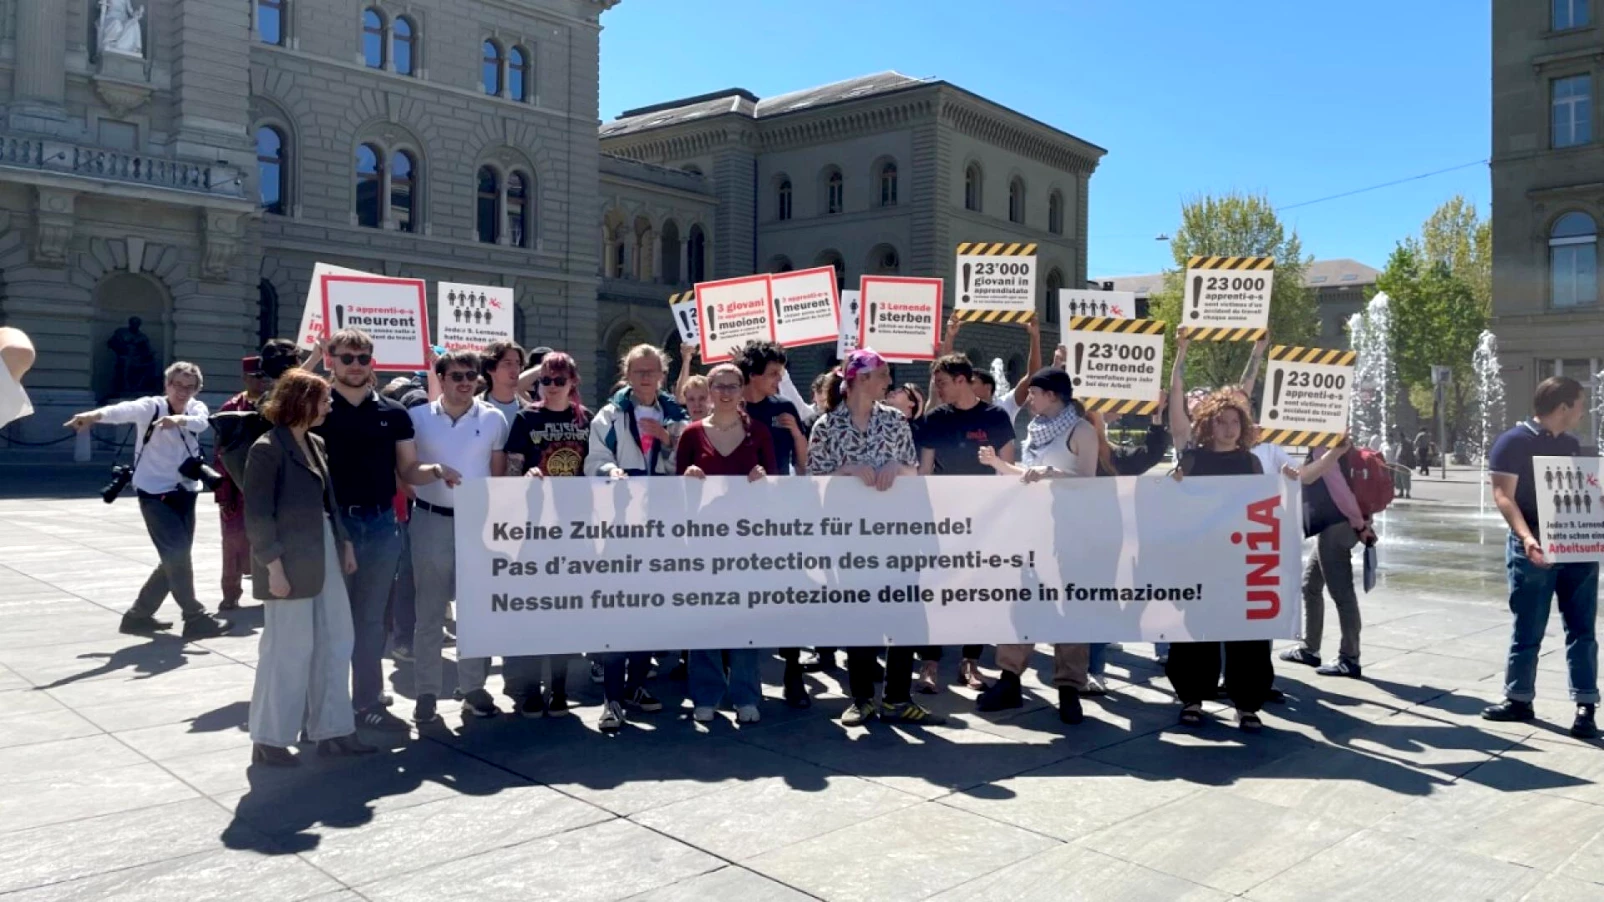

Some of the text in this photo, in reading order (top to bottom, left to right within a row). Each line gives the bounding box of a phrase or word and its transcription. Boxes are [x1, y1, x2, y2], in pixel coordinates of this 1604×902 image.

[974, 277, 1028, 287] giovani in
[1205, 293, 1263, 301] apprenti-e-s
[717, 299, 764, 313] 3 giovani
[783, 298, 830, 312] meurent
[879, 302, 931, 312] 3 Lernende
[356, 307, 414, 315] apprenti-e-s
[348, 316, 415, 327] meurent
[719, 317, 766, 329] muoiono
[879, 312, 931, 323] sterben
[1088, 343, 1155, 361] 23'000
[1087, 360, 1154, 374] Lernende
[1285, 390, 1344, 401] apprenti-e-s
[493, 518, 972, 541] Keine Zukunft ohne Schutz für Lernende!
[1547, 532, 1567, 540] hatte
[1569, 532, 1590, 540] schon
[492, 558, 538, 576] Pas
[650, 558, 704, 572] sans
[712, 552, 832, 575] protection
[838, 552, 879, 570] des
[492, 583, 1202, 612] Nessun futuro senza protezione delle persone in formazione!
